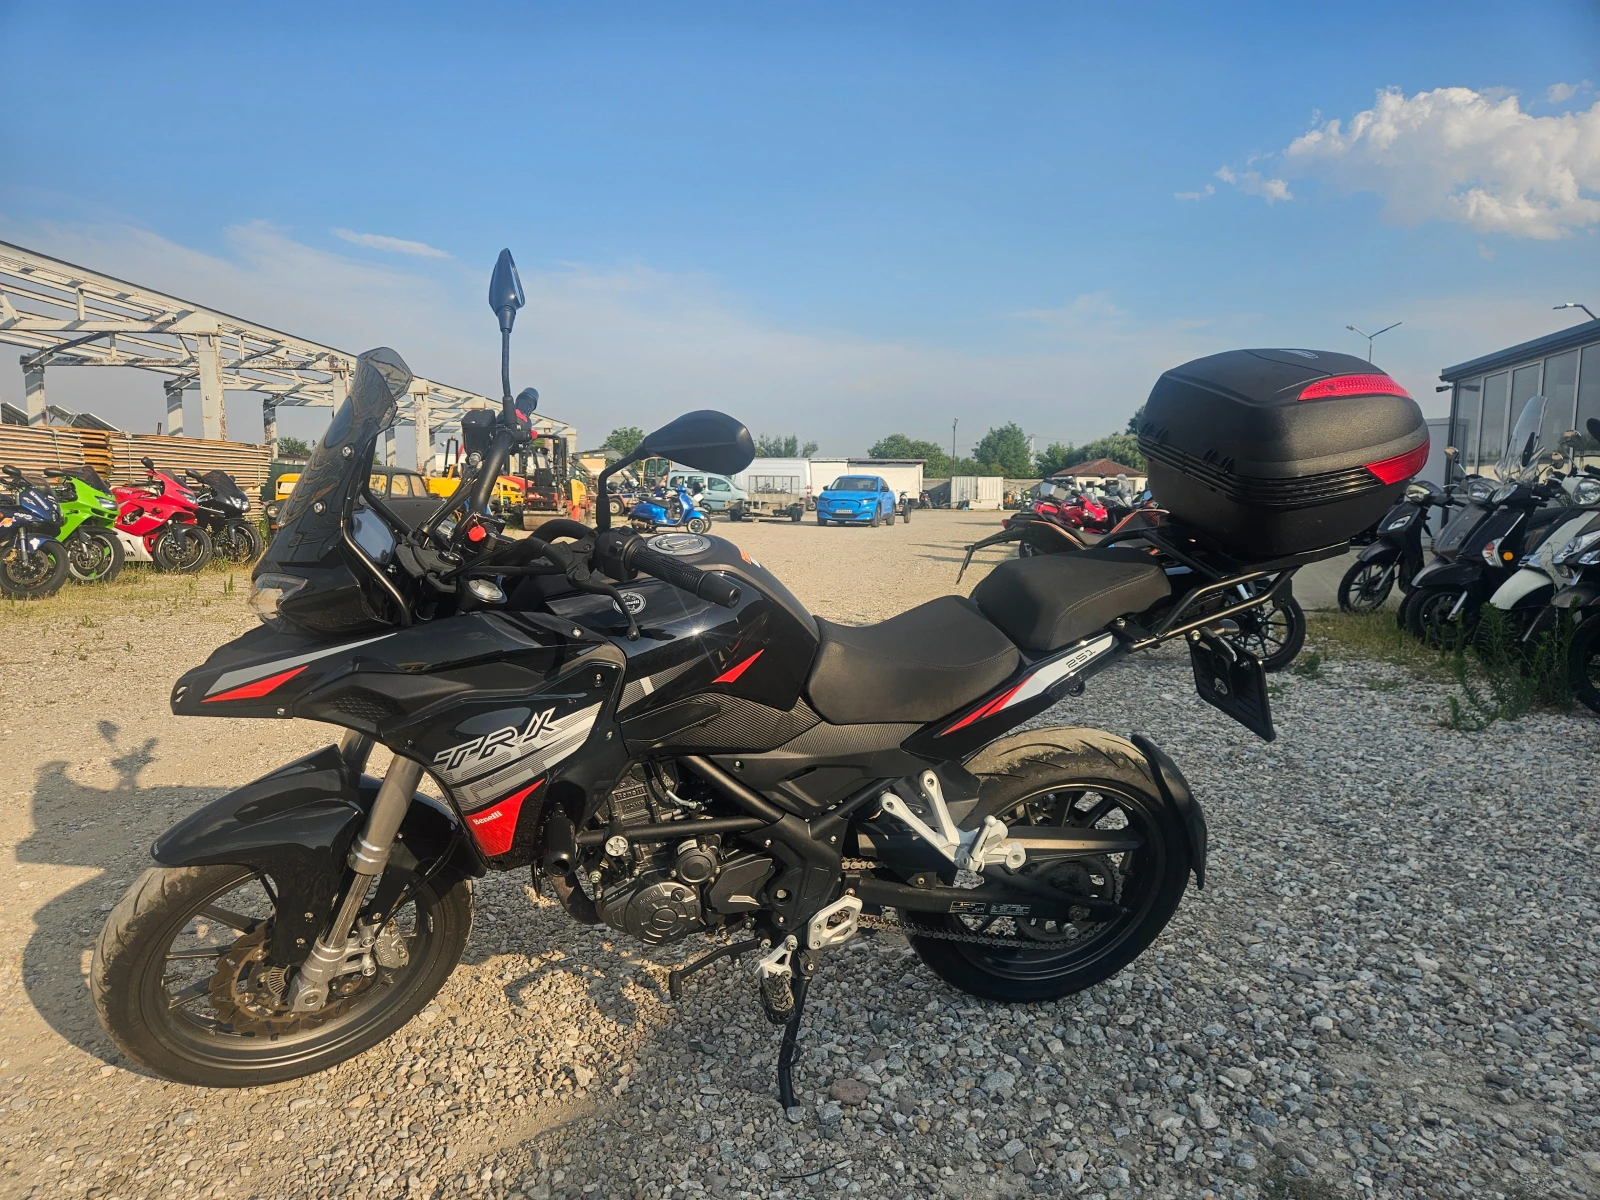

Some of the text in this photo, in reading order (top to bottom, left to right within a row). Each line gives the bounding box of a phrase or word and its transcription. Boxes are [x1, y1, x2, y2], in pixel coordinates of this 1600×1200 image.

[1066, 649, 1096, 669] 251
[433, 706, 557, 774] TRK
[472, 810, 503, 826] Benelli
